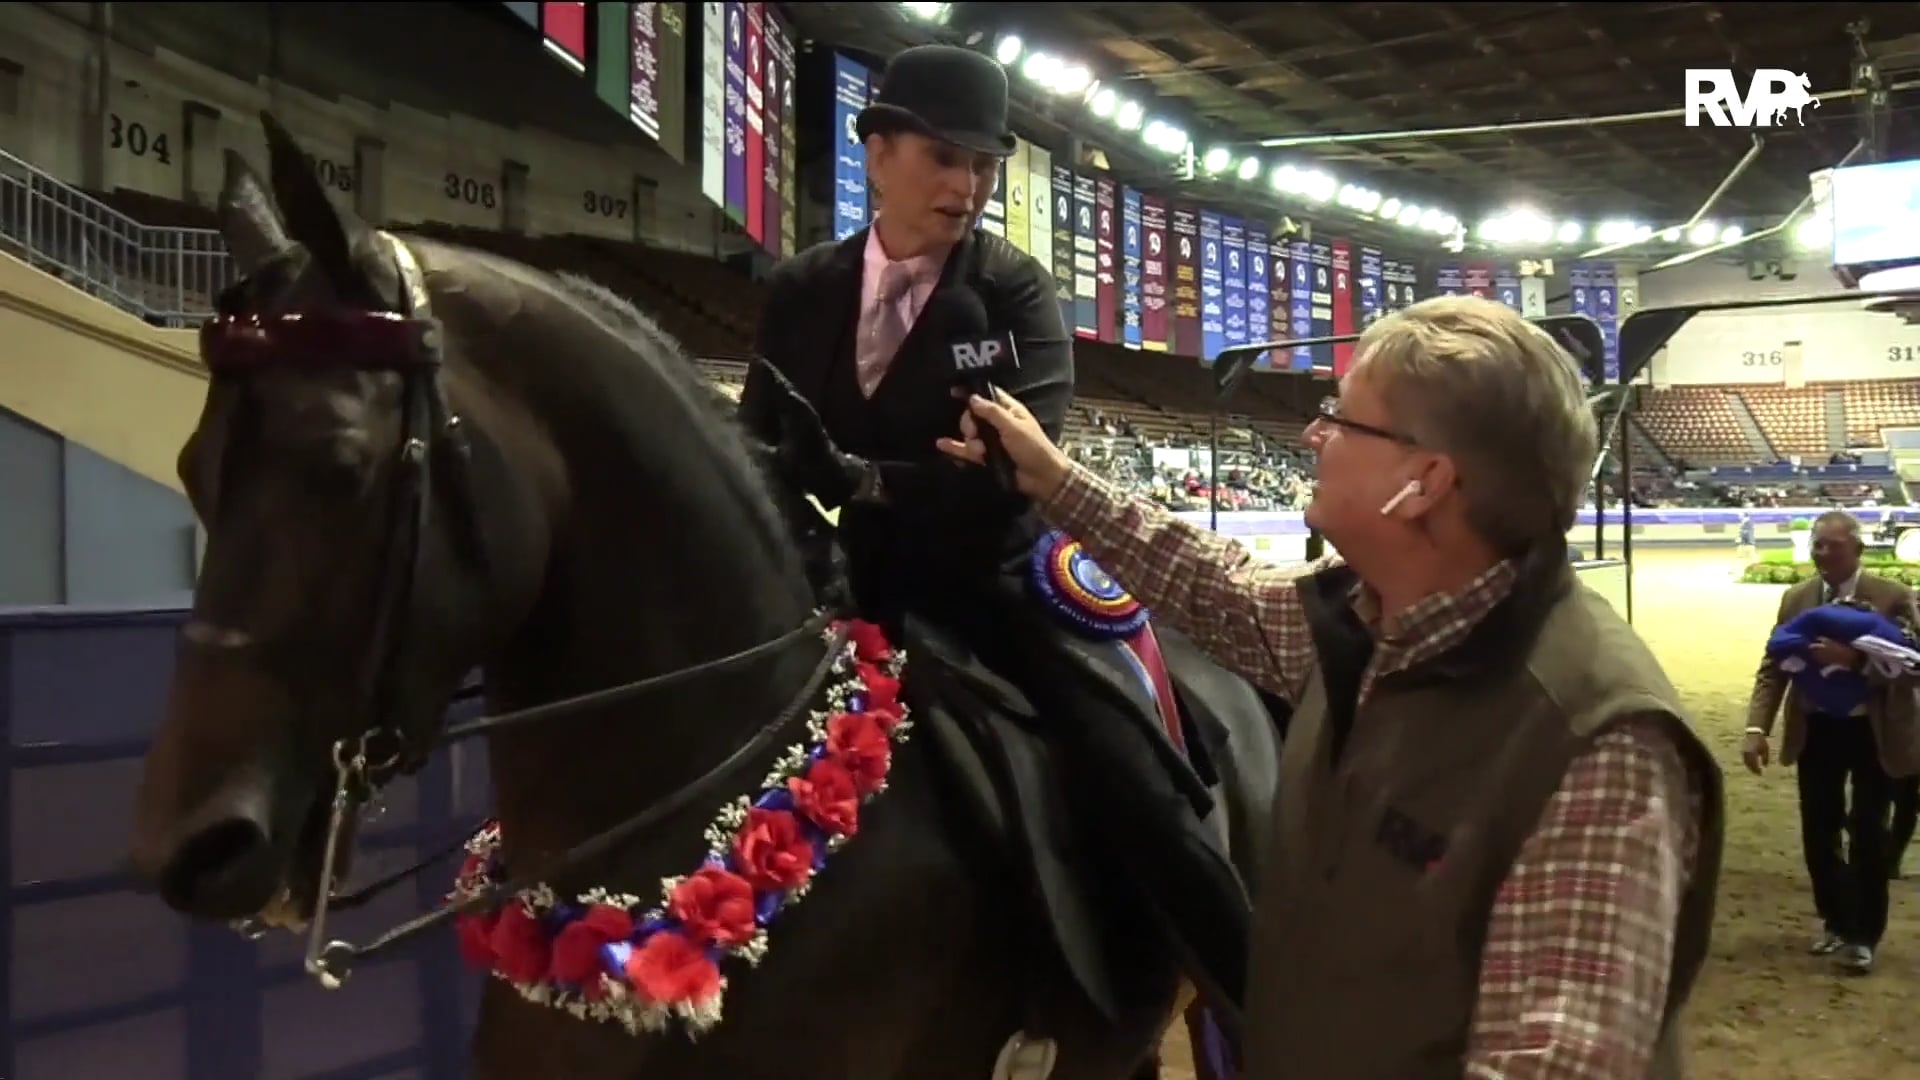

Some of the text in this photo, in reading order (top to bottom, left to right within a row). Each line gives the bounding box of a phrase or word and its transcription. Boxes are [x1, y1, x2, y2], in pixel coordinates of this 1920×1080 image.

[110, 112, 171, 166] 304
[312, 156, 353, 191] 05
[444, 173, 496, 210] 306
[583, 190, 627, 219] 307
[951, 339, 1001, 370] RVP
[1742, 350, 1783, 367] 316
[1888, 346, 1920, 362] 31
